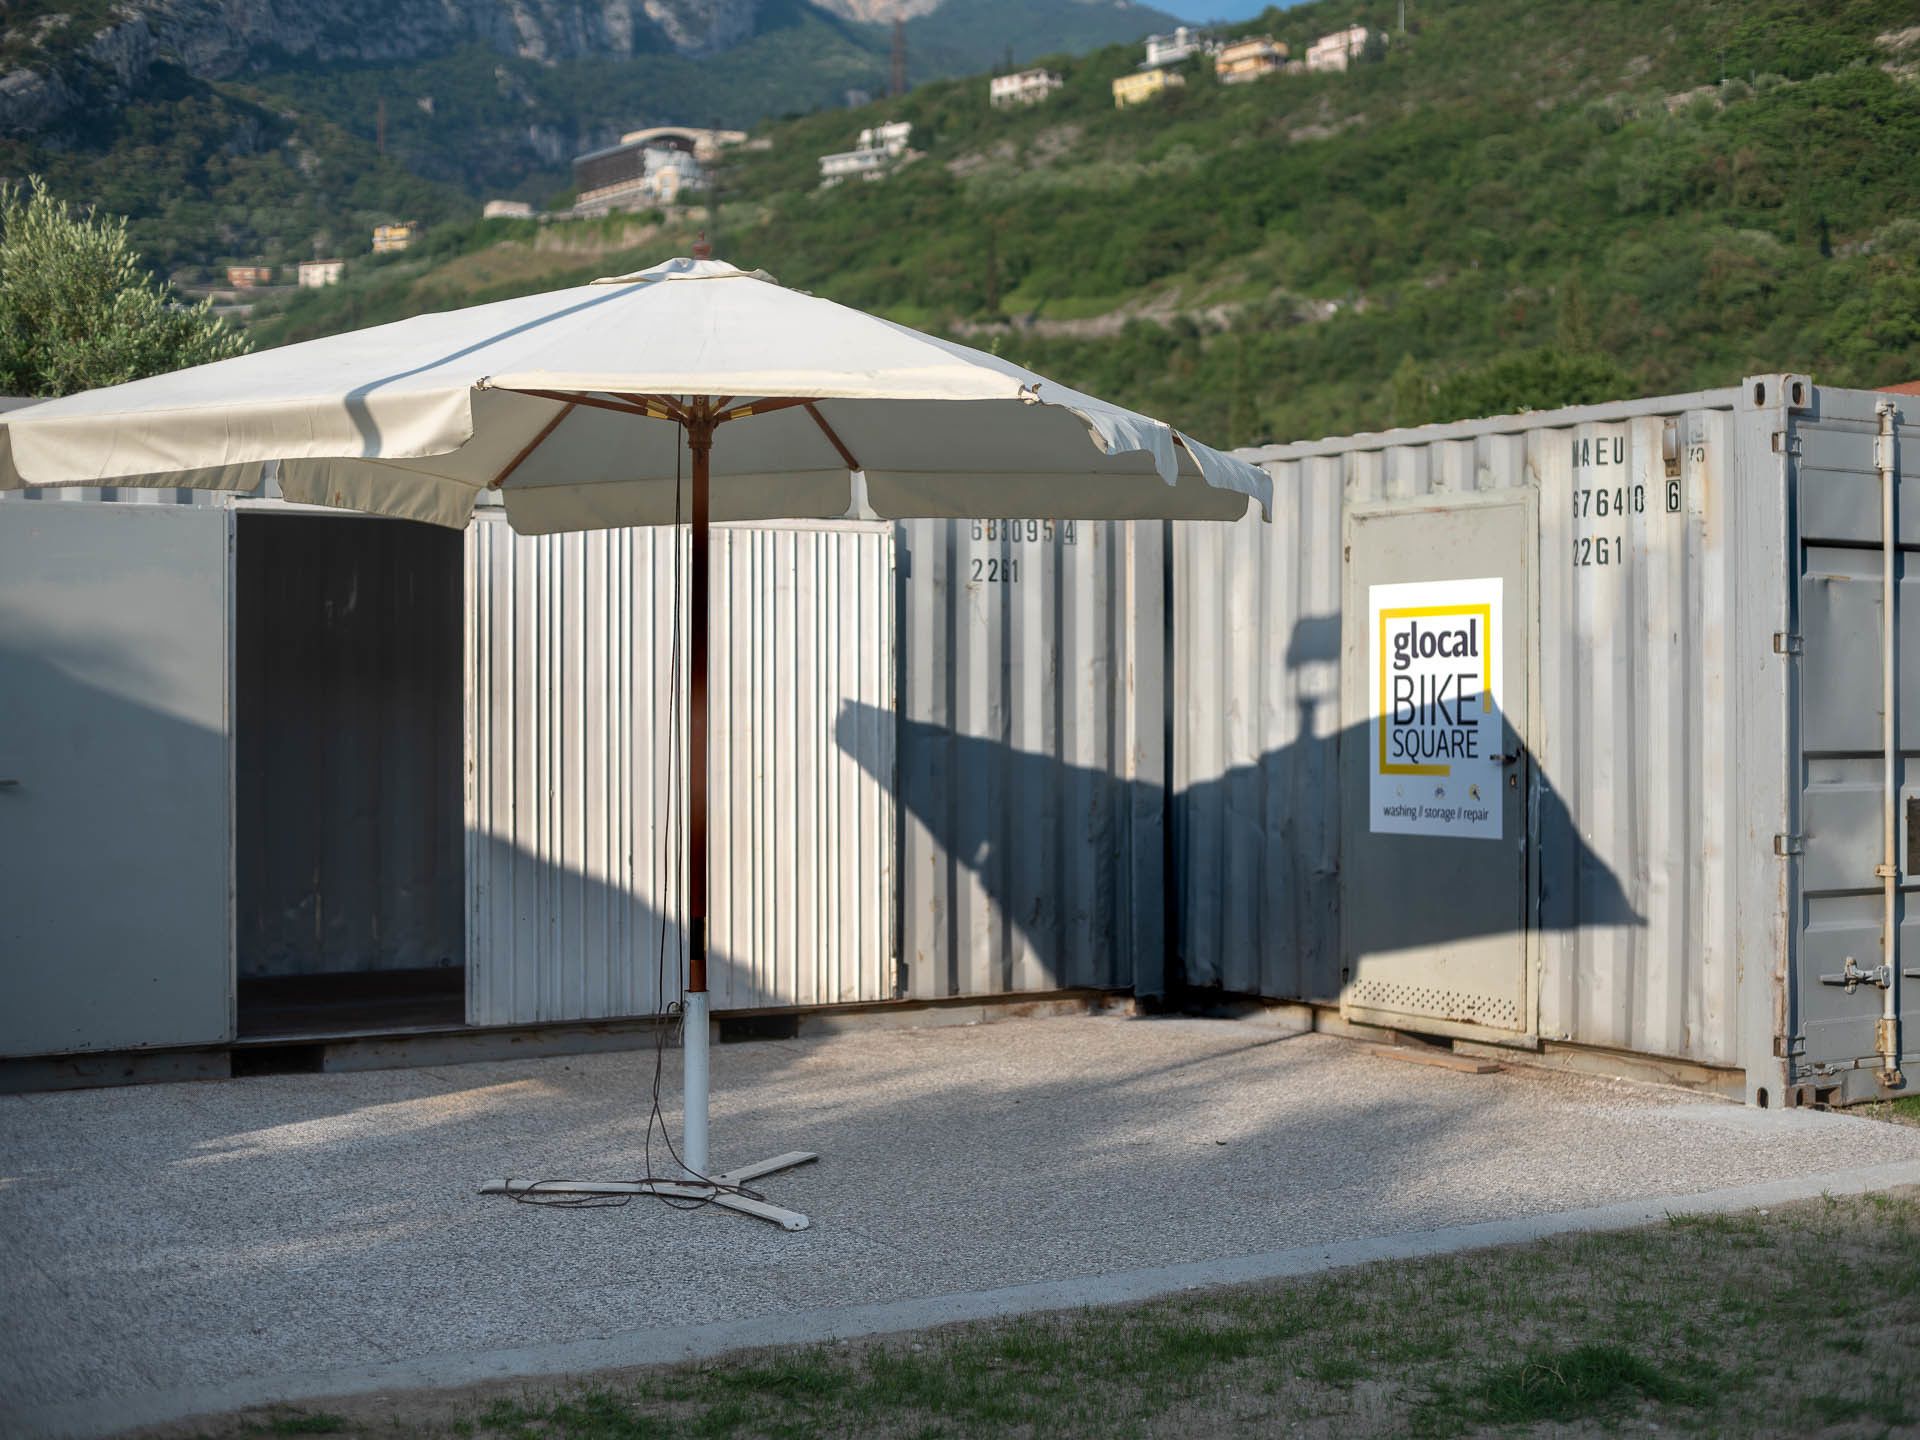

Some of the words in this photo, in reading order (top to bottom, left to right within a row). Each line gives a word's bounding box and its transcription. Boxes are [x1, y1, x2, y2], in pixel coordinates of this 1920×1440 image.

[1573, 484, 1645, 519] 676410
[1065, 519, 1075, 543] 4
[1573, 535, 1622, 567] 22G1
[1393, 618, 1479, 671] glocal
[1393, 673, 1479, 726] BIKE
[1392, 729, 1479, 763] SQUARE
[1383, 804, 1417, 822] washing
[1424, 807, 1456, 823] storage
[1463, 807, 1489, 824] repair
